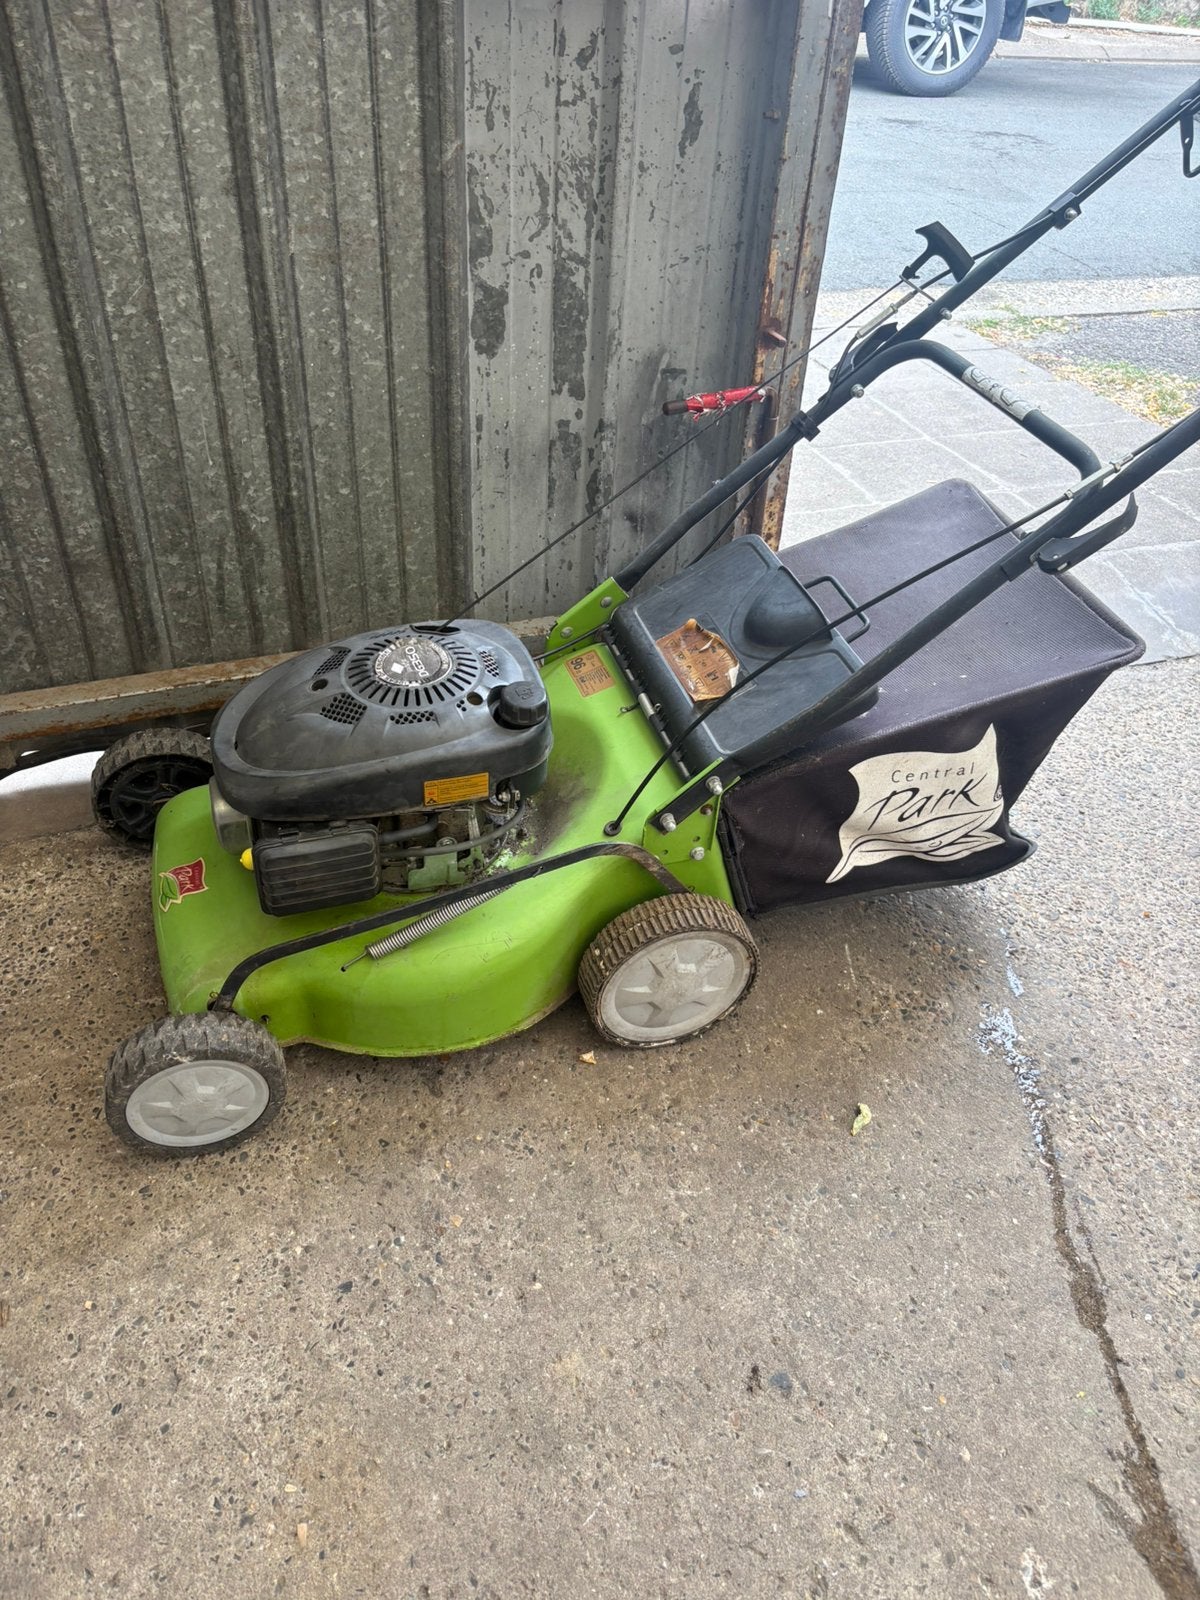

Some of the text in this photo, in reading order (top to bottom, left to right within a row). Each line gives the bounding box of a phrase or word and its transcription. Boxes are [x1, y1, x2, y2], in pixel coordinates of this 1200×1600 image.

[570, 657, 586, 671] 96
[891, 762, 974, 783] Central
[864, 773, 987, 831] Park
[174, 866, 195, 892] Park
